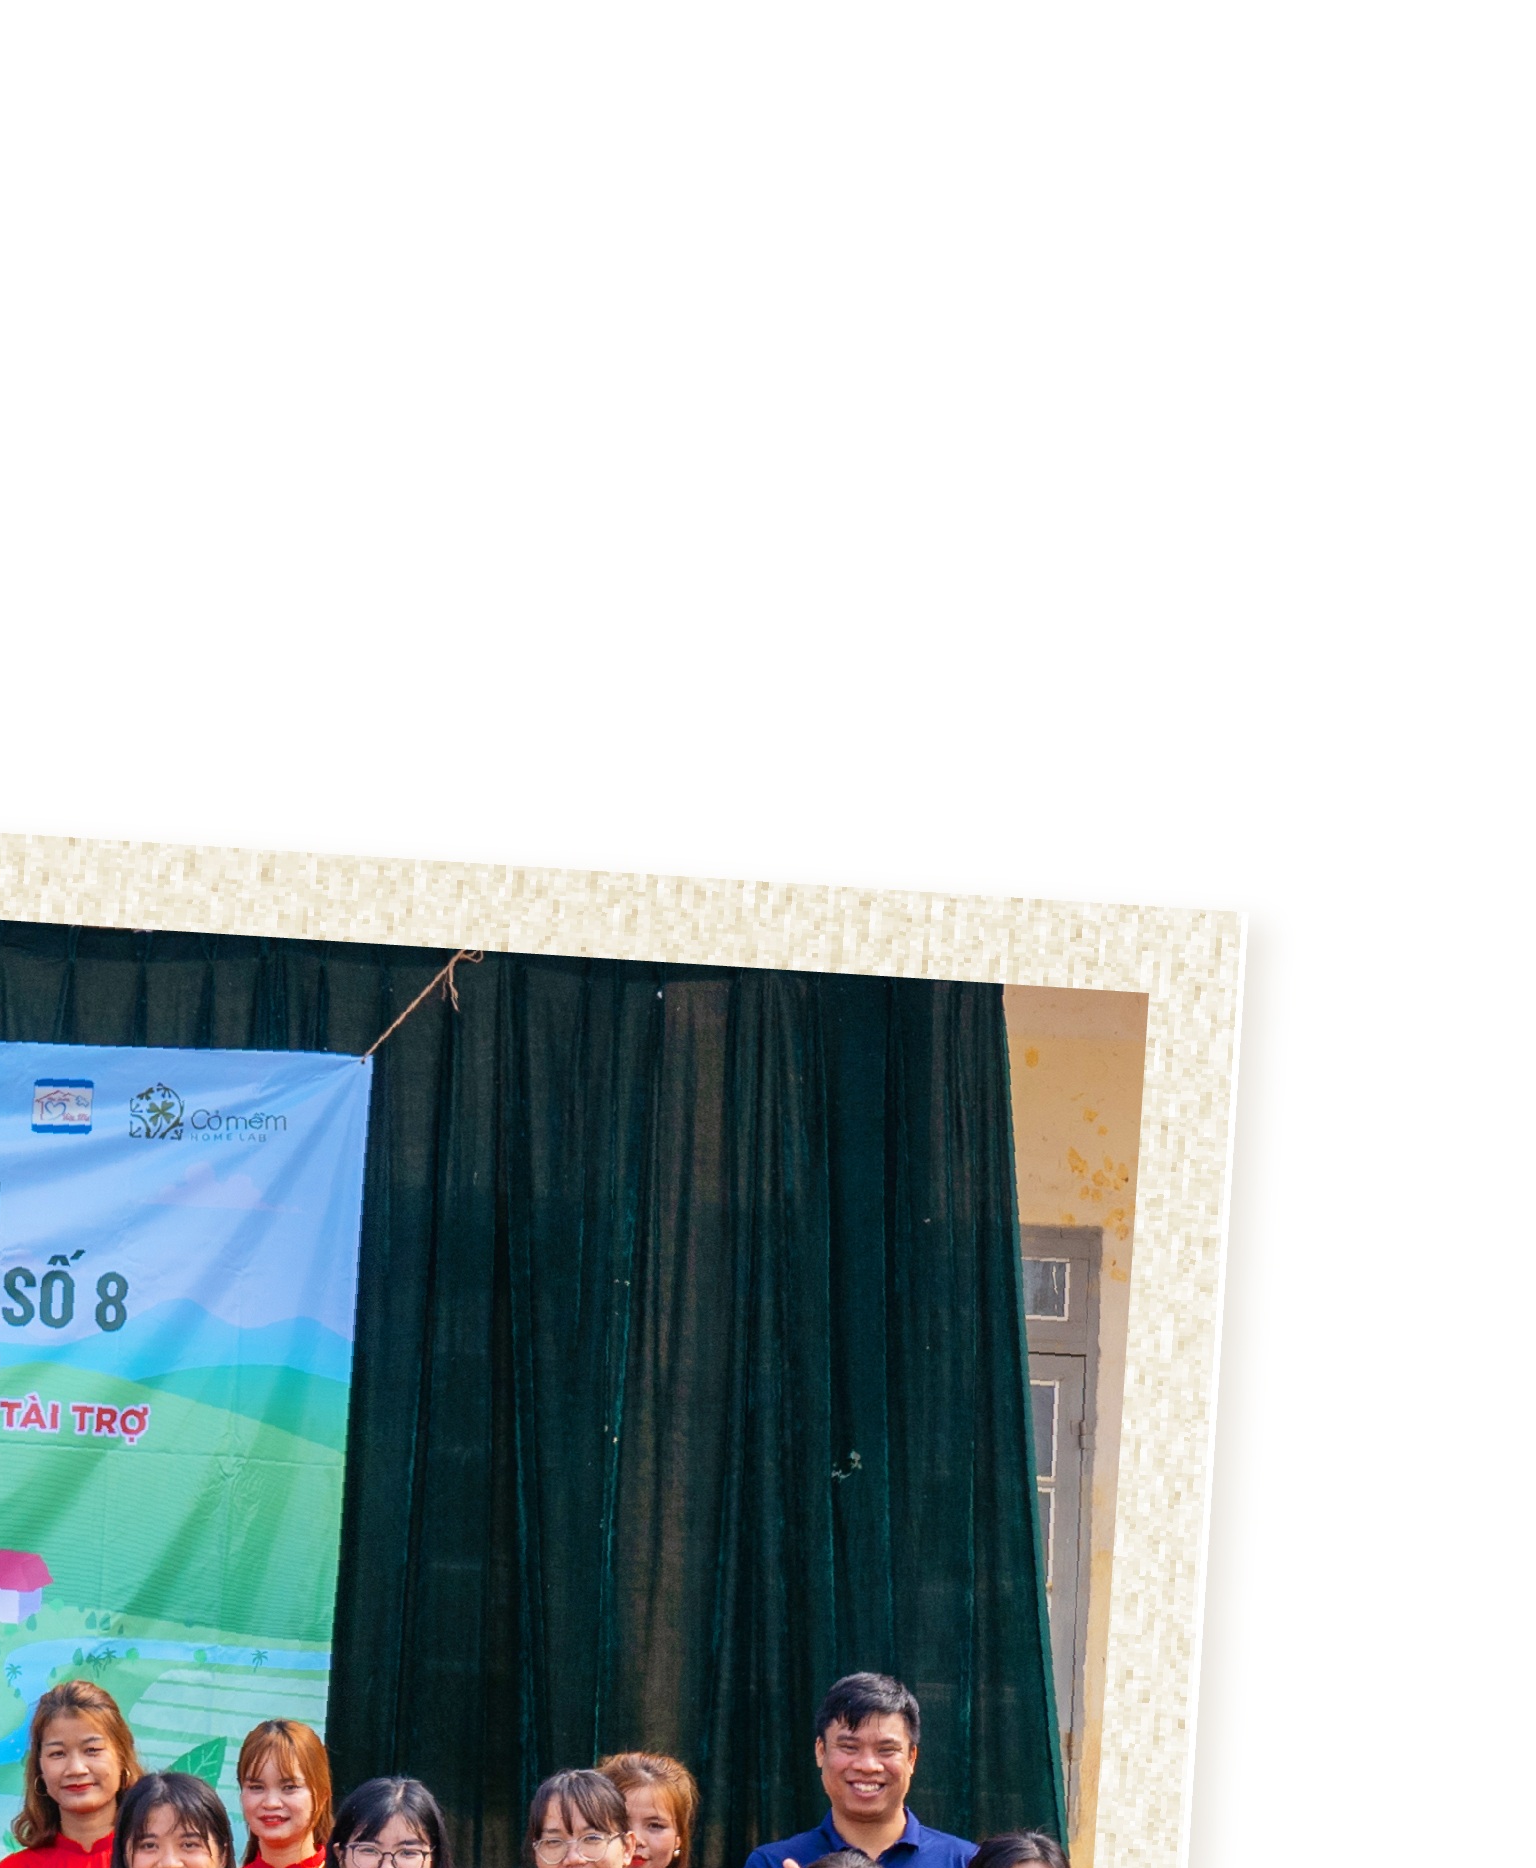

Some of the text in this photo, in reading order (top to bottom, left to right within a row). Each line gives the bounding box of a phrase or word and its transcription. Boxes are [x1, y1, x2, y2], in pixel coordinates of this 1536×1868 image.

[191, 1133, 267, 1142] HOME LAB
[3, 1249, 87, 1330] SỐ
[95, 1270, 130, 1332] 8
[0, 1392, 58, 1430] TÀI
[72, 1405, 149, 1443] TRỢ
